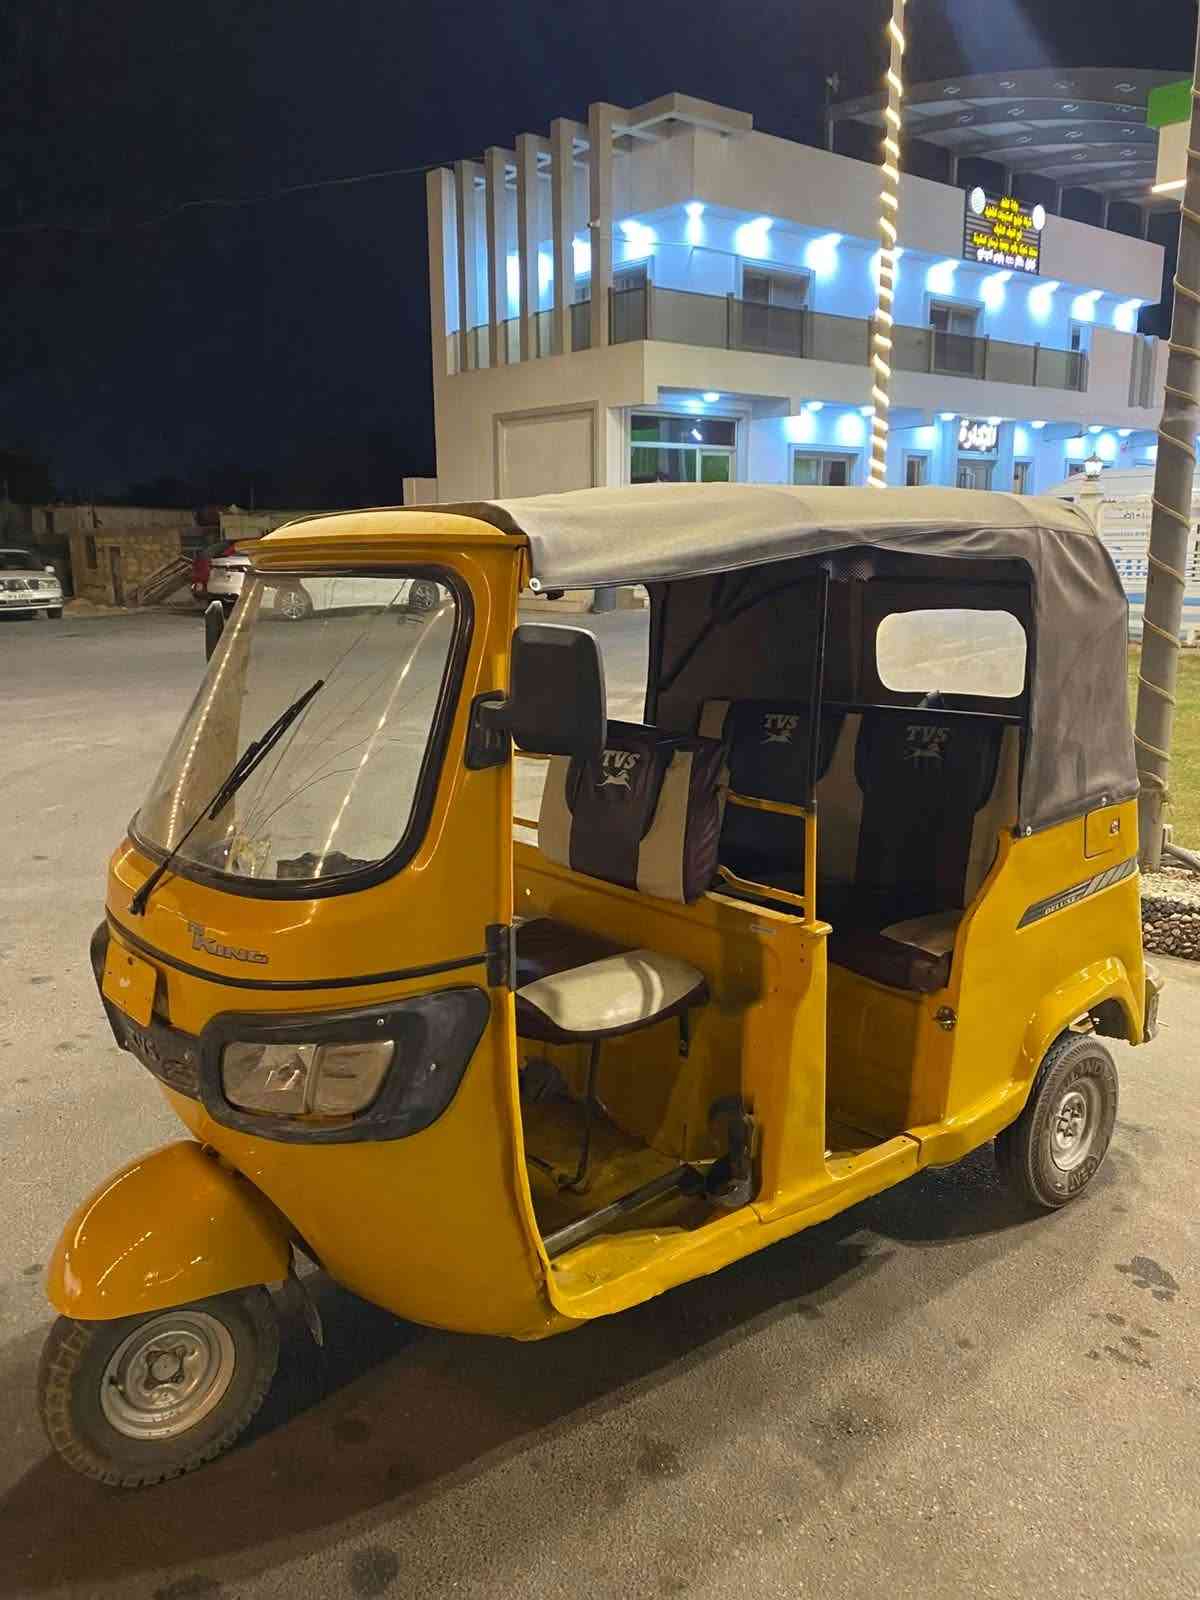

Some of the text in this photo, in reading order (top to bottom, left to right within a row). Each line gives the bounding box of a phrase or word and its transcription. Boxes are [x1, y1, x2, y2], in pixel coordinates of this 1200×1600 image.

[764, 713, 800, 729] TVS
[906, 725, 951, 742] TVS
[602, 750, 641, 769] TVS
